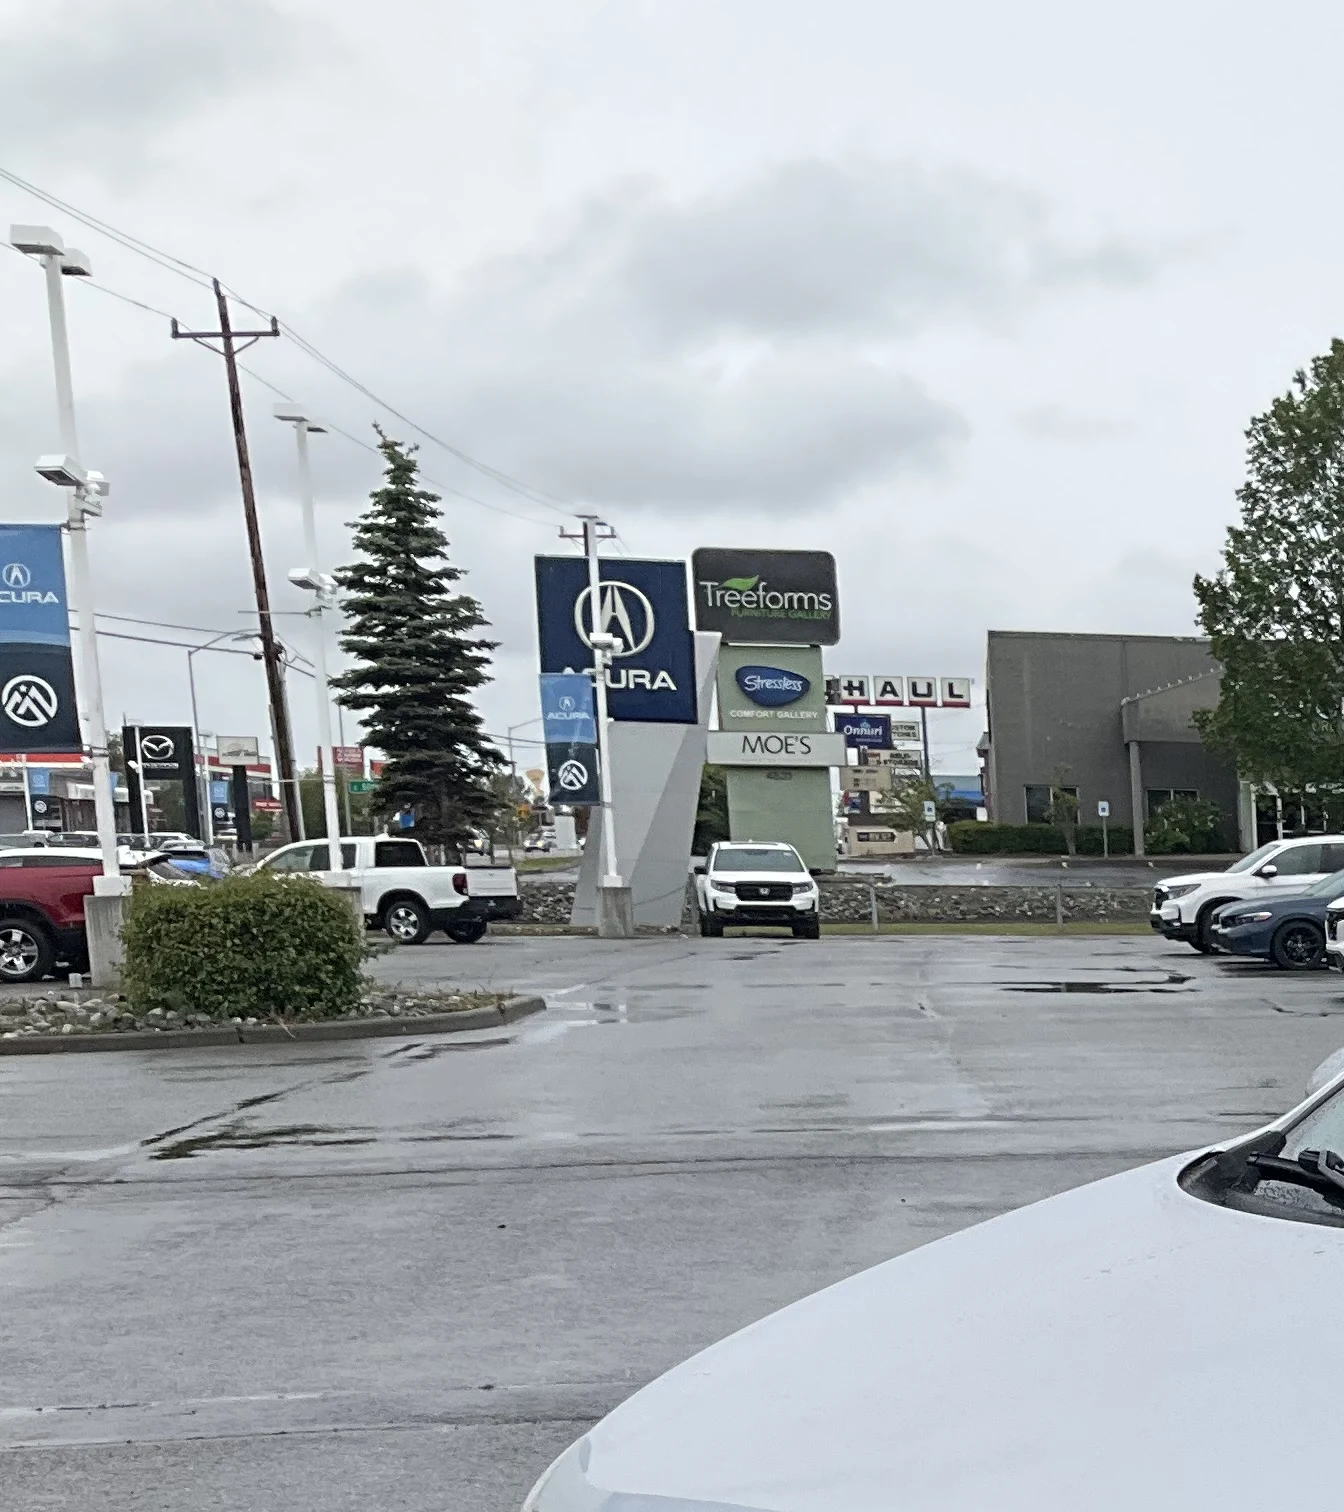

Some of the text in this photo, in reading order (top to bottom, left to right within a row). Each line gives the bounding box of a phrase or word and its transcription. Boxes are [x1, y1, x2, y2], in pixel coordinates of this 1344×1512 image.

[0, 591, 59, 603] CURA
[699, 581, 832, 611] Treeforms
[788, 609, 831, 619] GALLERY
[744, 675, 803, 691] Stressless
[729, 710, 818, 719] COMFORT GALLERY
[843, 724, 883, 735] Onnuri
[742, 735, 811, 754] MOE'S
